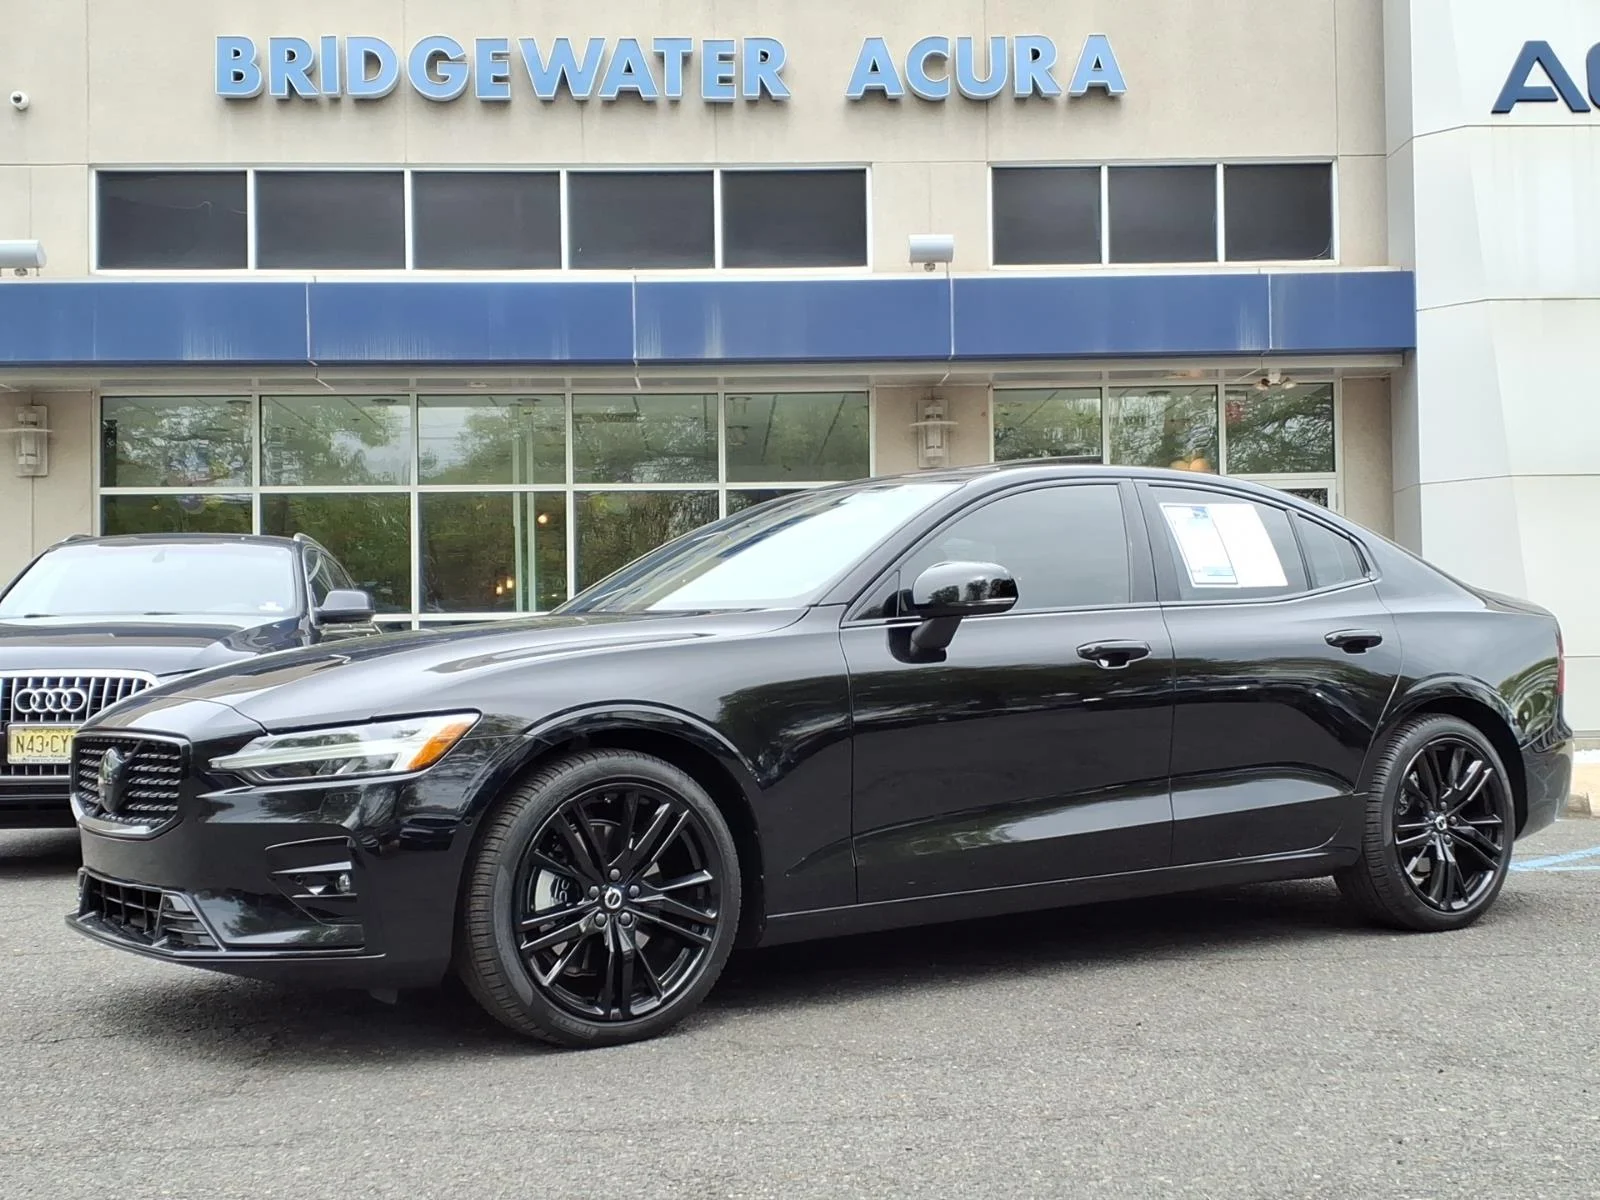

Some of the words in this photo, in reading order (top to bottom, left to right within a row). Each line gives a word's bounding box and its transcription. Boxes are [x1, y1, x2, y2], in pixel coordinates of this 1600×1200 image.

[215, 34, 791, 102] BRIDGEWATER
[844, 33, 1128, 101] ACURA
[1490, 40, 1600, 114] A
